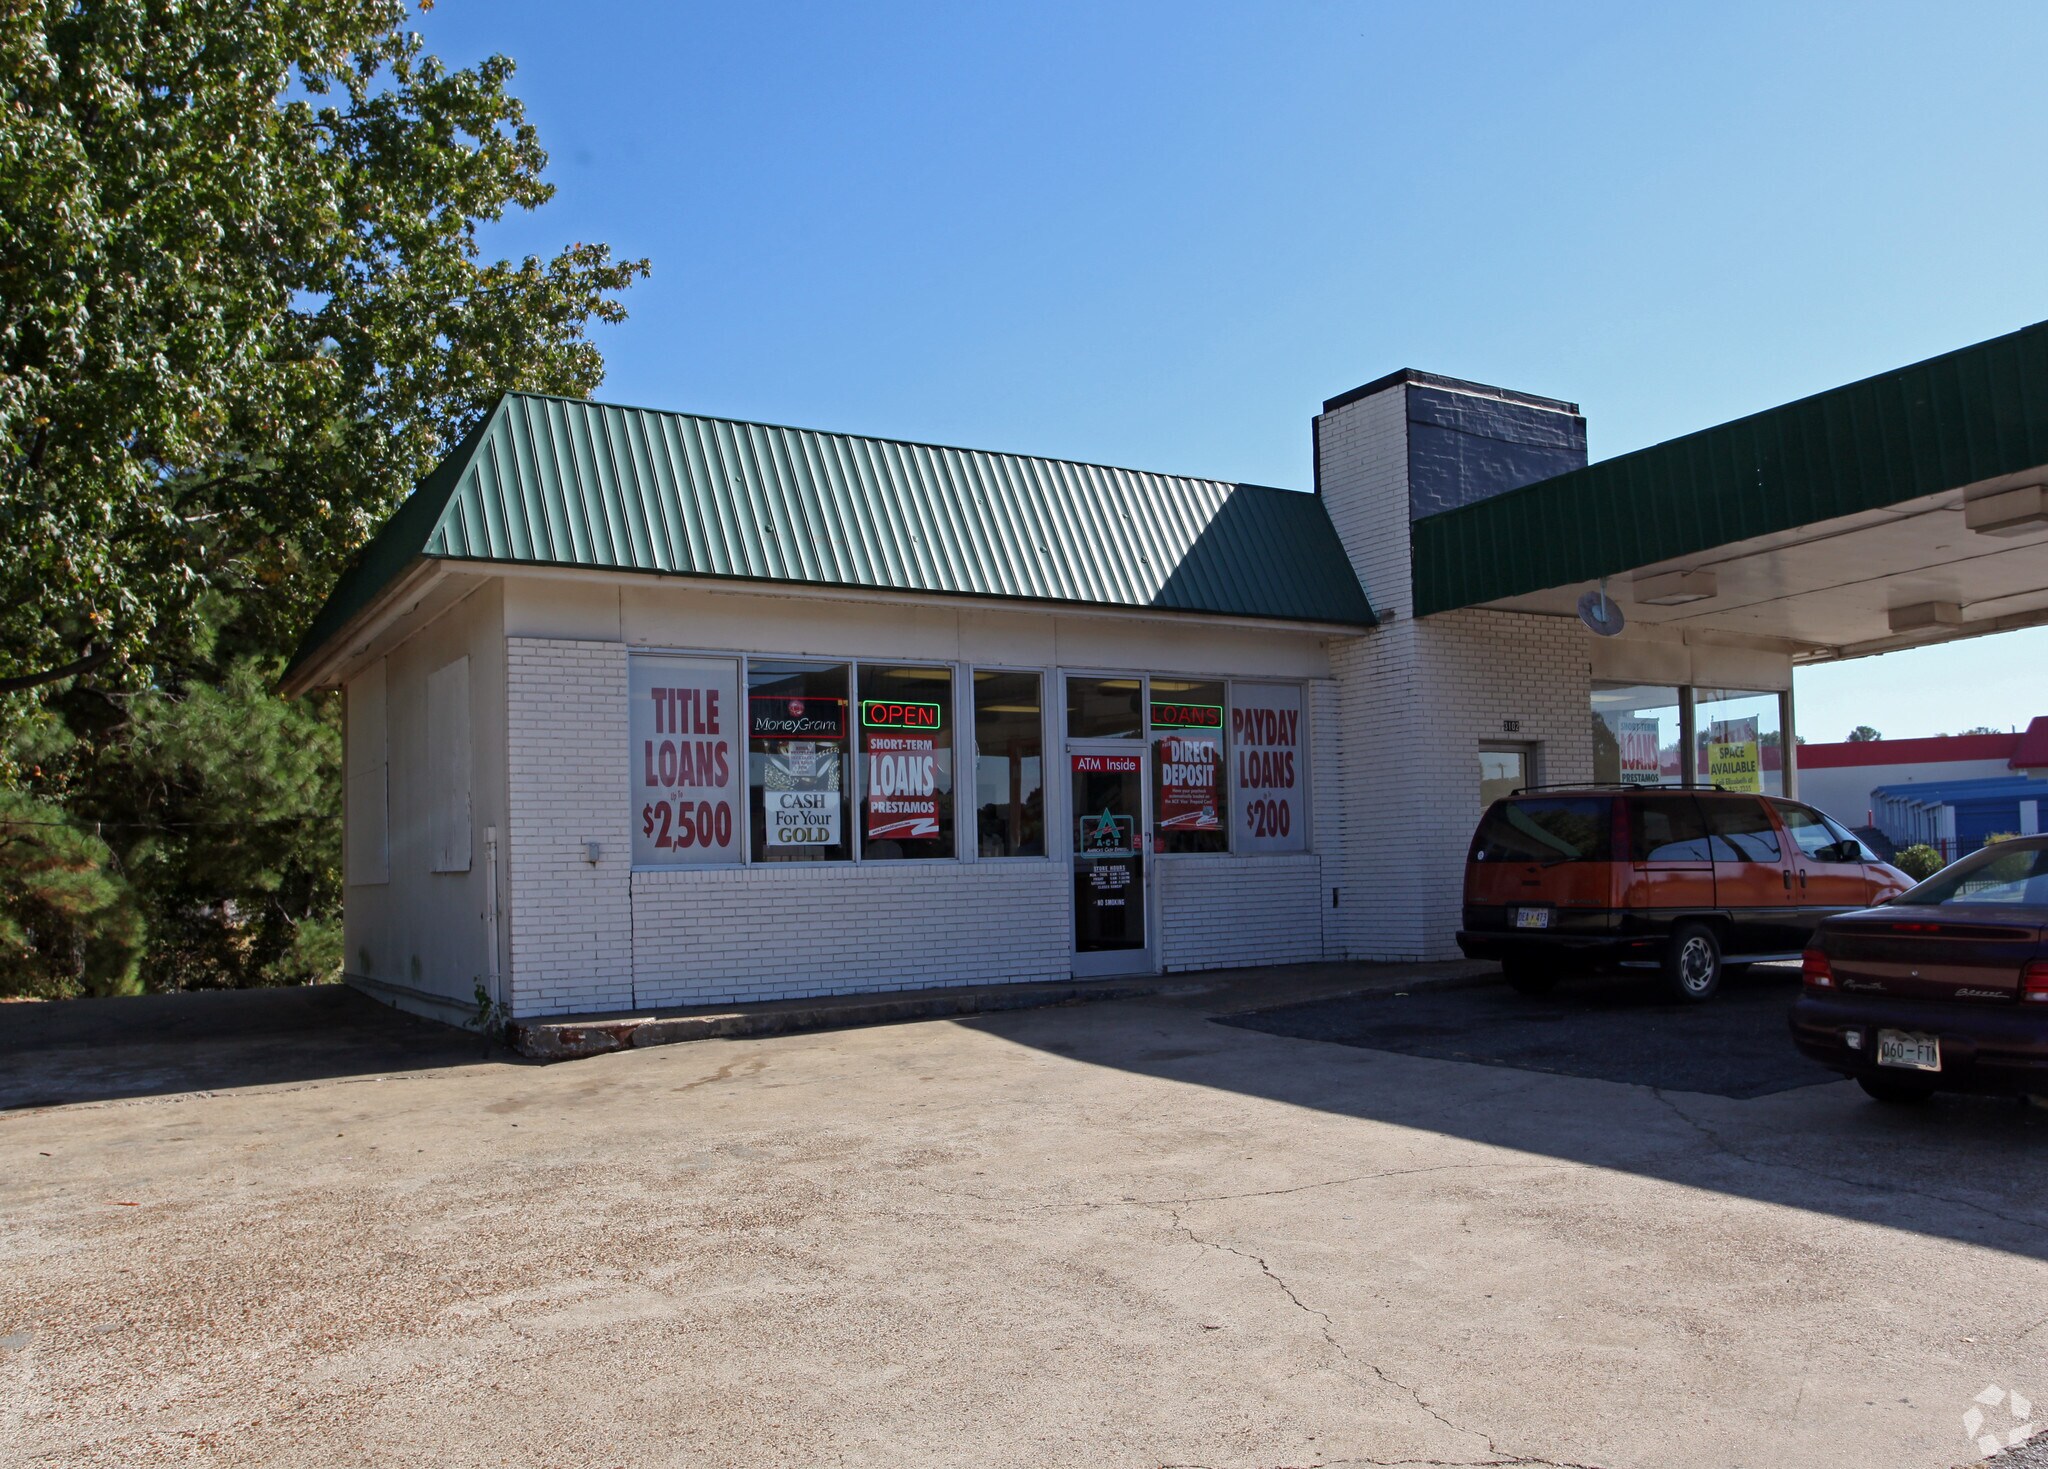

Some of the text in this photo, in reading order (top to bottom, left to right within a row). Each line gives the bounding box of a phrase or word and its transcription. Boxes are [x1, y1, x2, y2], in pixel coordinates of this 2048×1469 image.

[651, 687, 720, 735] TITLE
[870, 704, 934, 726] OPEN
[1151, 705, 1218, 725] LOANS
[755, 717, 836, 733] MoneyGram
[1232, 707, 1299, 747] PAYDAY
[1504, 721, 1519, 731] 3102
[870, 738, 933, 751] SHORT-TERM
[1171, 740, 1214, 763] DIRECT
[1620, 733, 1658, 771] LOANS
[1719, 746, 1745, 759] SPACE
[644, 739, 729, 788] LOANS
[1077, 757, 1136, 771] ATM Inside
[1239, 750, 1295, 789] LOANS
[1711, 761, 1756, 776] AVAILABLE
[870, 754, 934, 797] LOANS
[1162, 763, 1214, 787] DEPOSIT
[1621, 773, 1659, 783] PRESTAMOS
[780, 793, 826, 809] CASH
[870, 801, 935, 814] PRESTAMOS
[776, 810, 832, 826] For Your
[1246, 799, 1290, 838] $200
[642, 800, 732, 853] $2,500
[778, 827, 830, 843] GOLD
[1105, 898, 1125, 906] SMOKING
[1843, 978, 1888, 991] Plymouth
[1954, 988, 2010, 999] Breeze
